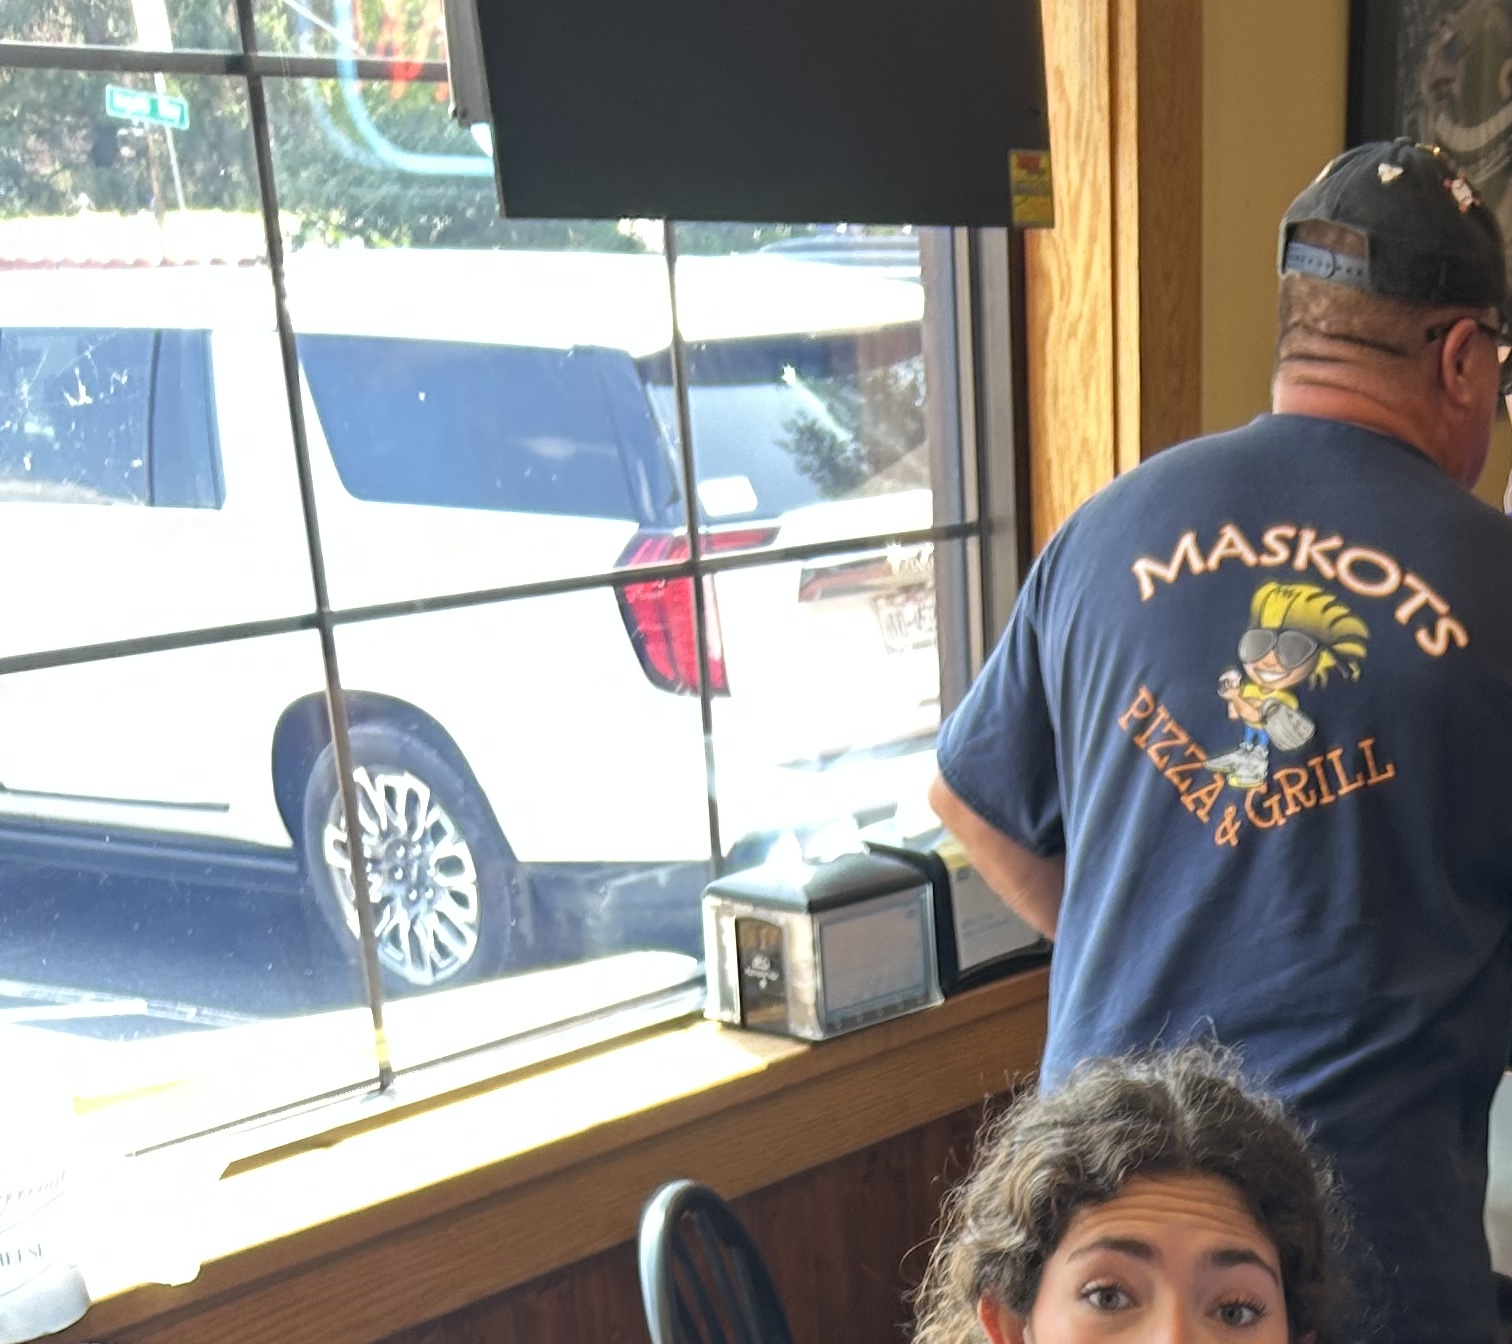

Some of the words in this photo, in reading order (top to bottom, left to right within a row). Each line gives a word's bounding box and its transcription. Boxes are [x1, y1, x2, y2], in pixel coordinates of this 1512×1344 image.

[1131, 523, 1470, 657] MASKOTS
[1118, 684, 1225, 823] PIZZA
[1214, 804, 1243, 847] &
[1243, 737, 1397, 829] GRILL
